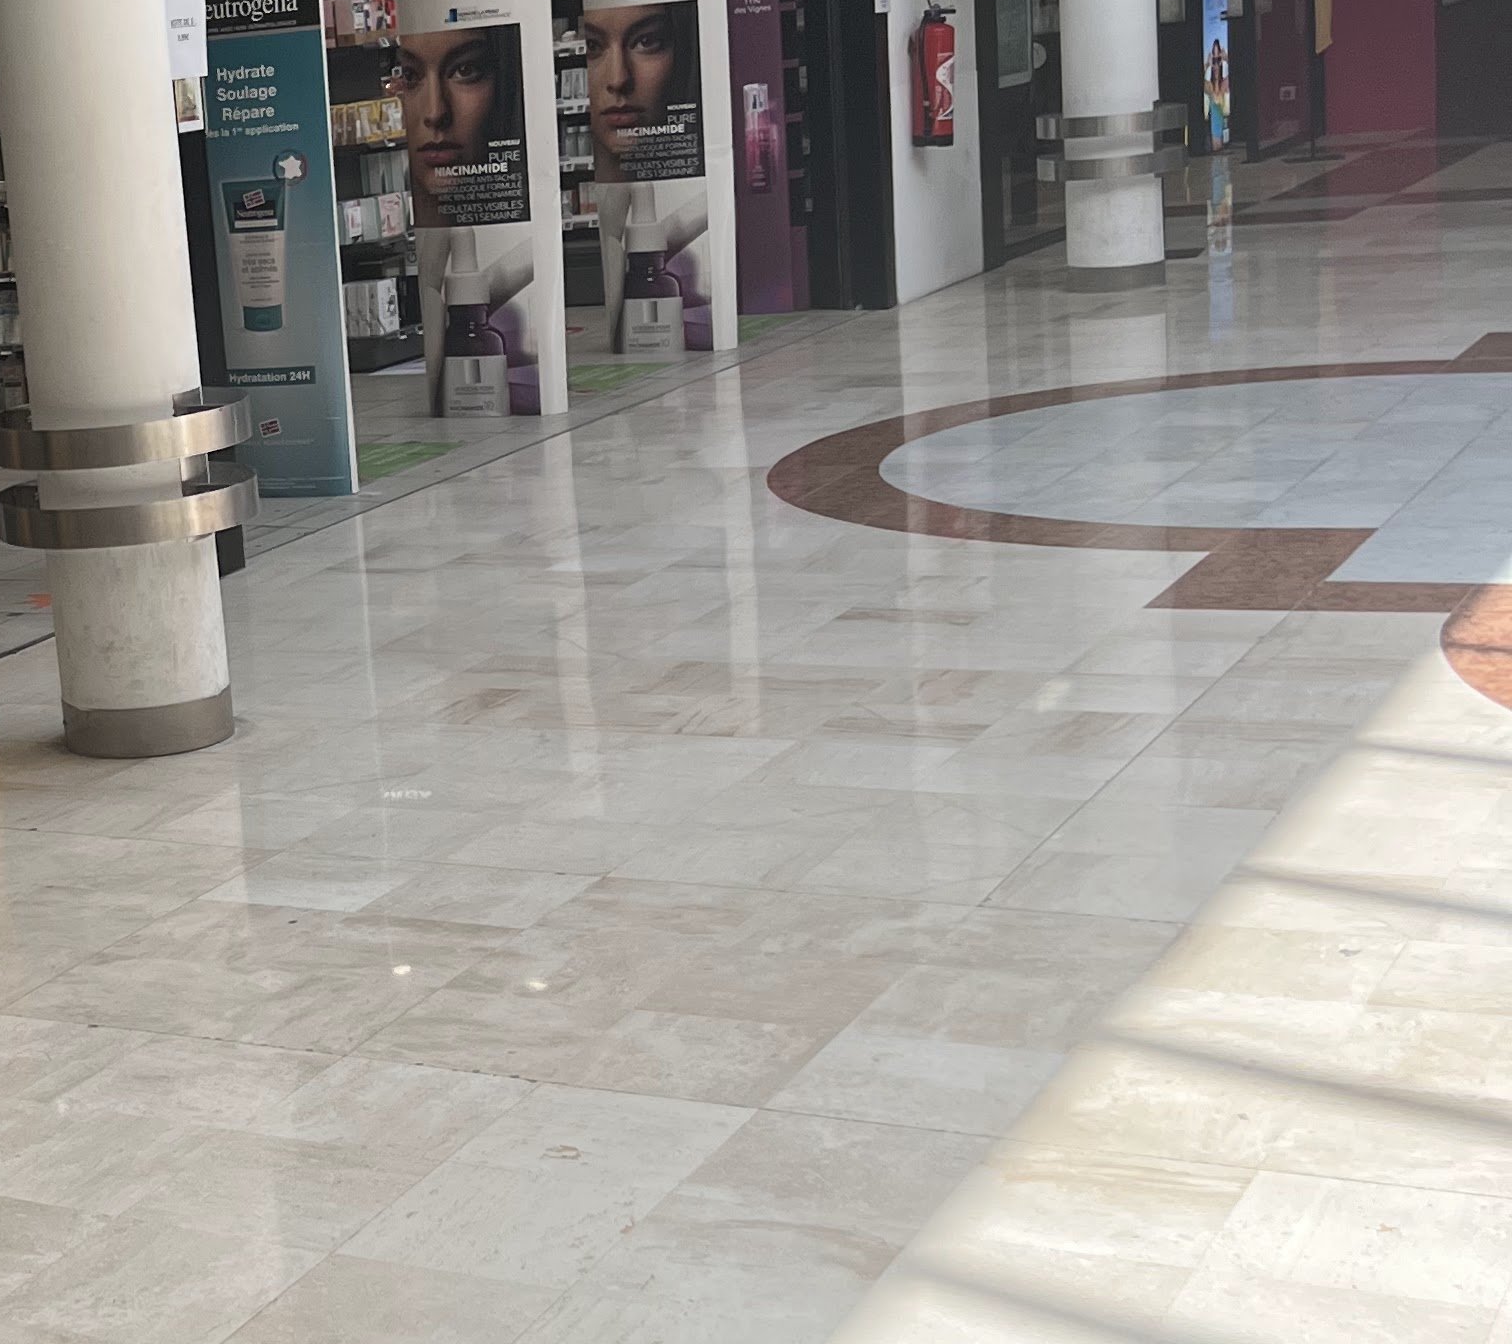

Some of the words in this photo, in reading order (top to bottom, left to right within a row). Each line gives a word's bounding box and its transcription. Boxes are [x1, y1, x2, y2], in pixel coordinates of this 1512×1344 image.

[216, 64, 275, 84] Hydrate
[216, 85, 278, 102] Soulage
[222, 105, 275, 123] Répare
[667, 113, 696, 124] PURE
[245, 122, 300, 136] application
[616, 124, 685, 137] NIACINAMIDE
[489, 150, 521, 163] PURE
[434, 162, 509, 177] NIACINAMIDE
[229, 372, 287, 384] Hydratation
[290, 370, 310, 382] 24H
